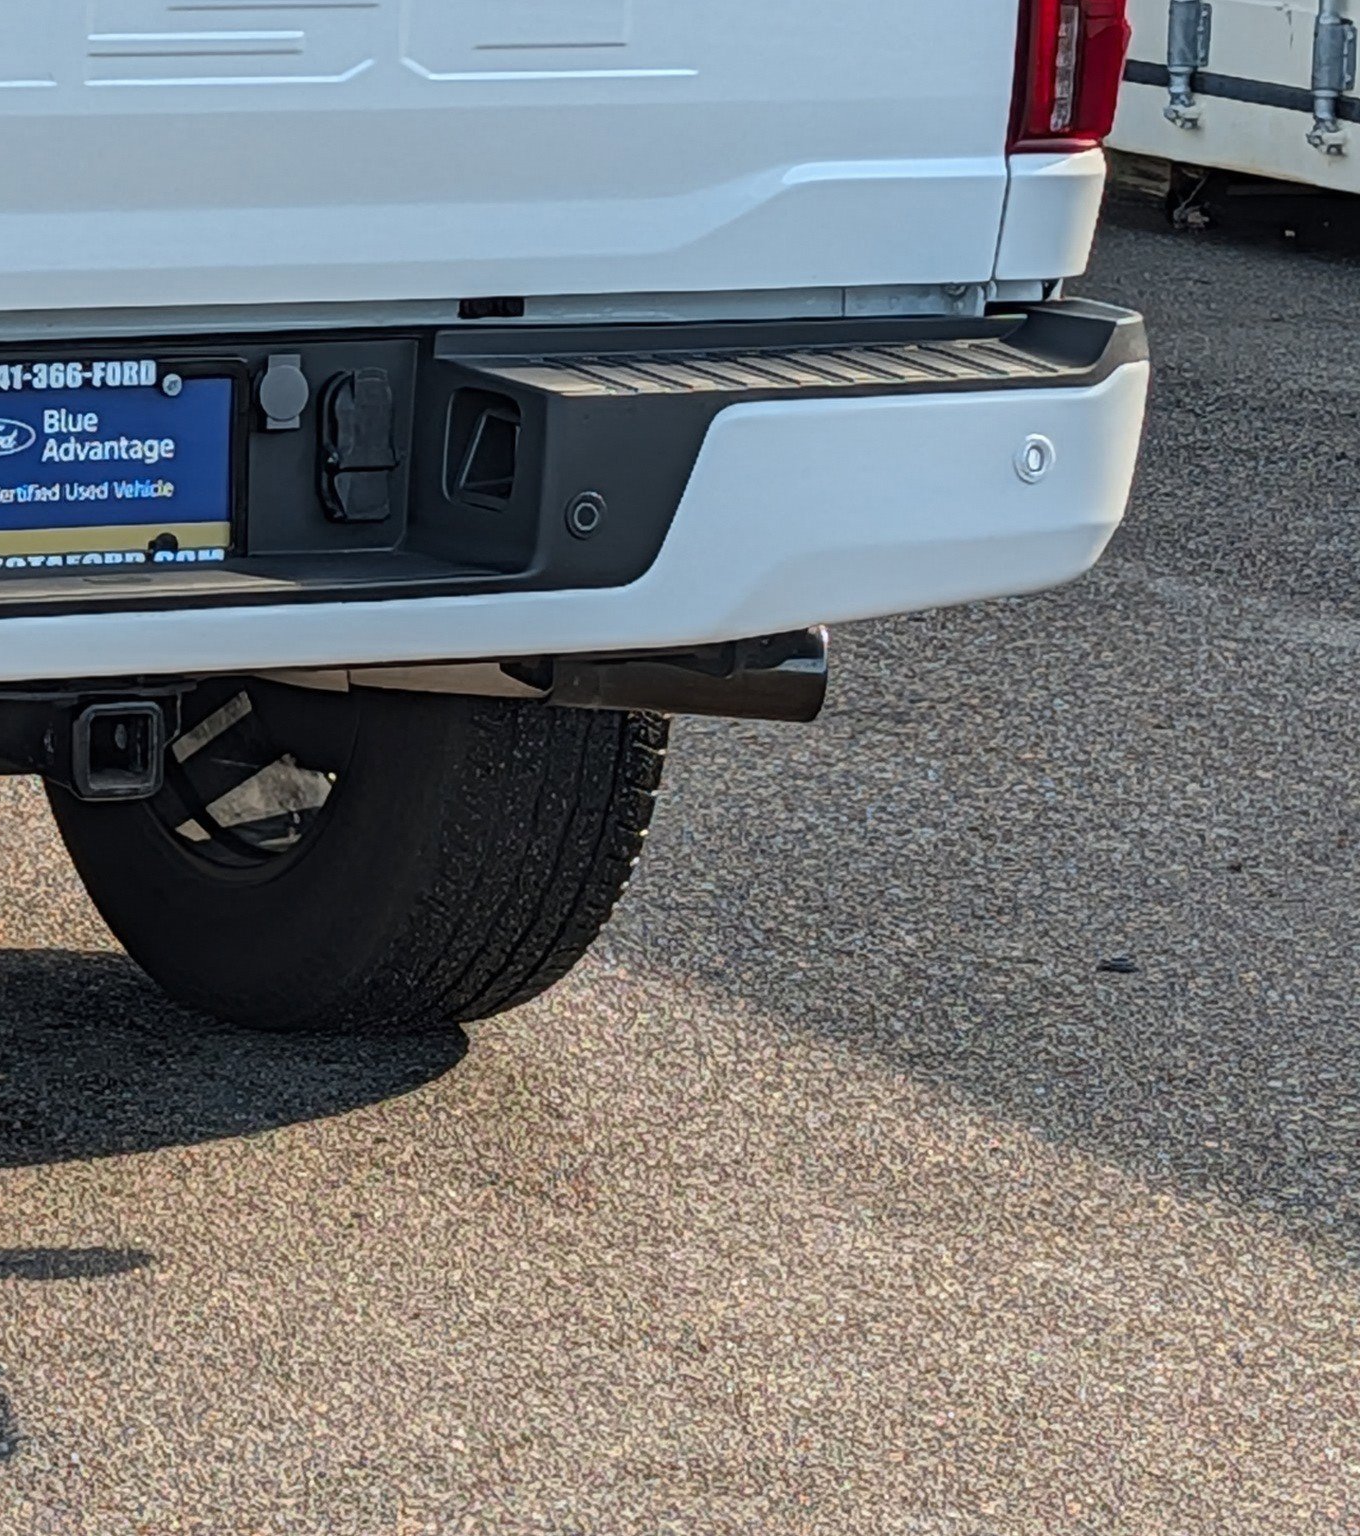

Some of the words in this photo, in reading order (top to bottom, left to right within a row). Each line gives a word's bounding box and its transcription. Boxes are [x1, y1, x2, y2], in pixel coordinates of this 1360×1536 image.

[43, 409, 99, 434] Blue
[41, 435, 175, 464] Advantage
[65, 481, 109, 501] Used
[114, 479, 175, 499] Vehicle
